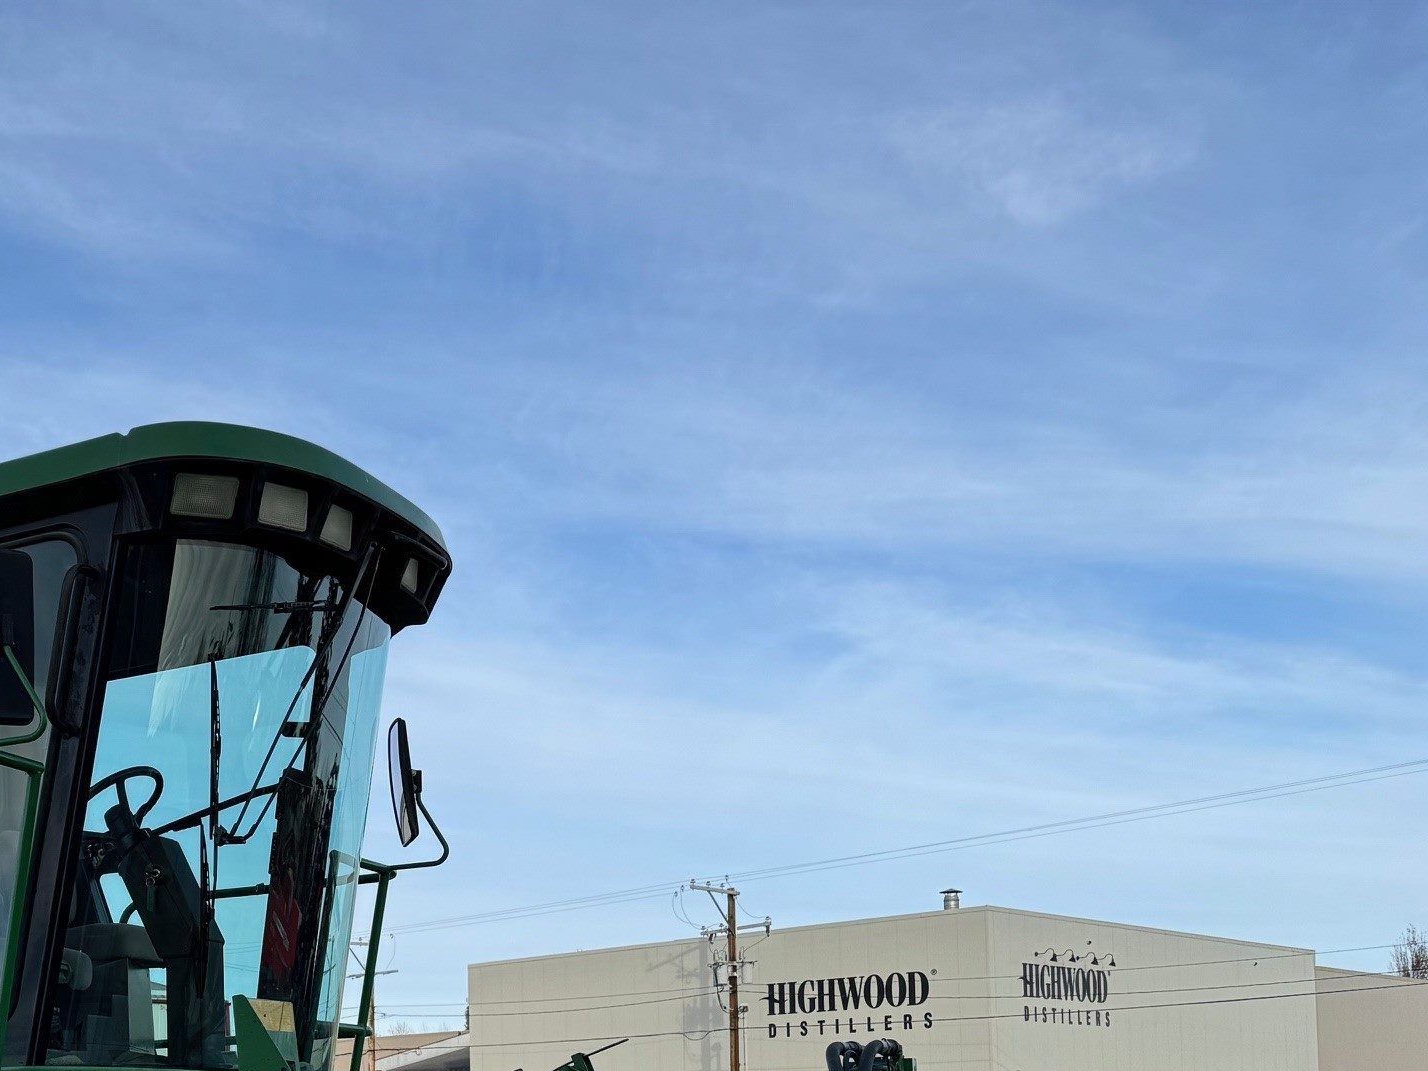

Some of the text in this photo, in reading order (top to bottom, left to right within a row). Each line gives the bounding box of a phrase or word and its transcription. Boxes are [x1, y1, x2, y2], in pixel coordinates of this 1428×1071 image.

[760, 970, 931, 1016] HIGHWOOD
[1019, 963, 1109, 1003] HIGHWOOD
[768, 1012, 933, 1038] DISTILLERS
[1024, 1005, 1111, 1027] DISTILLERS
